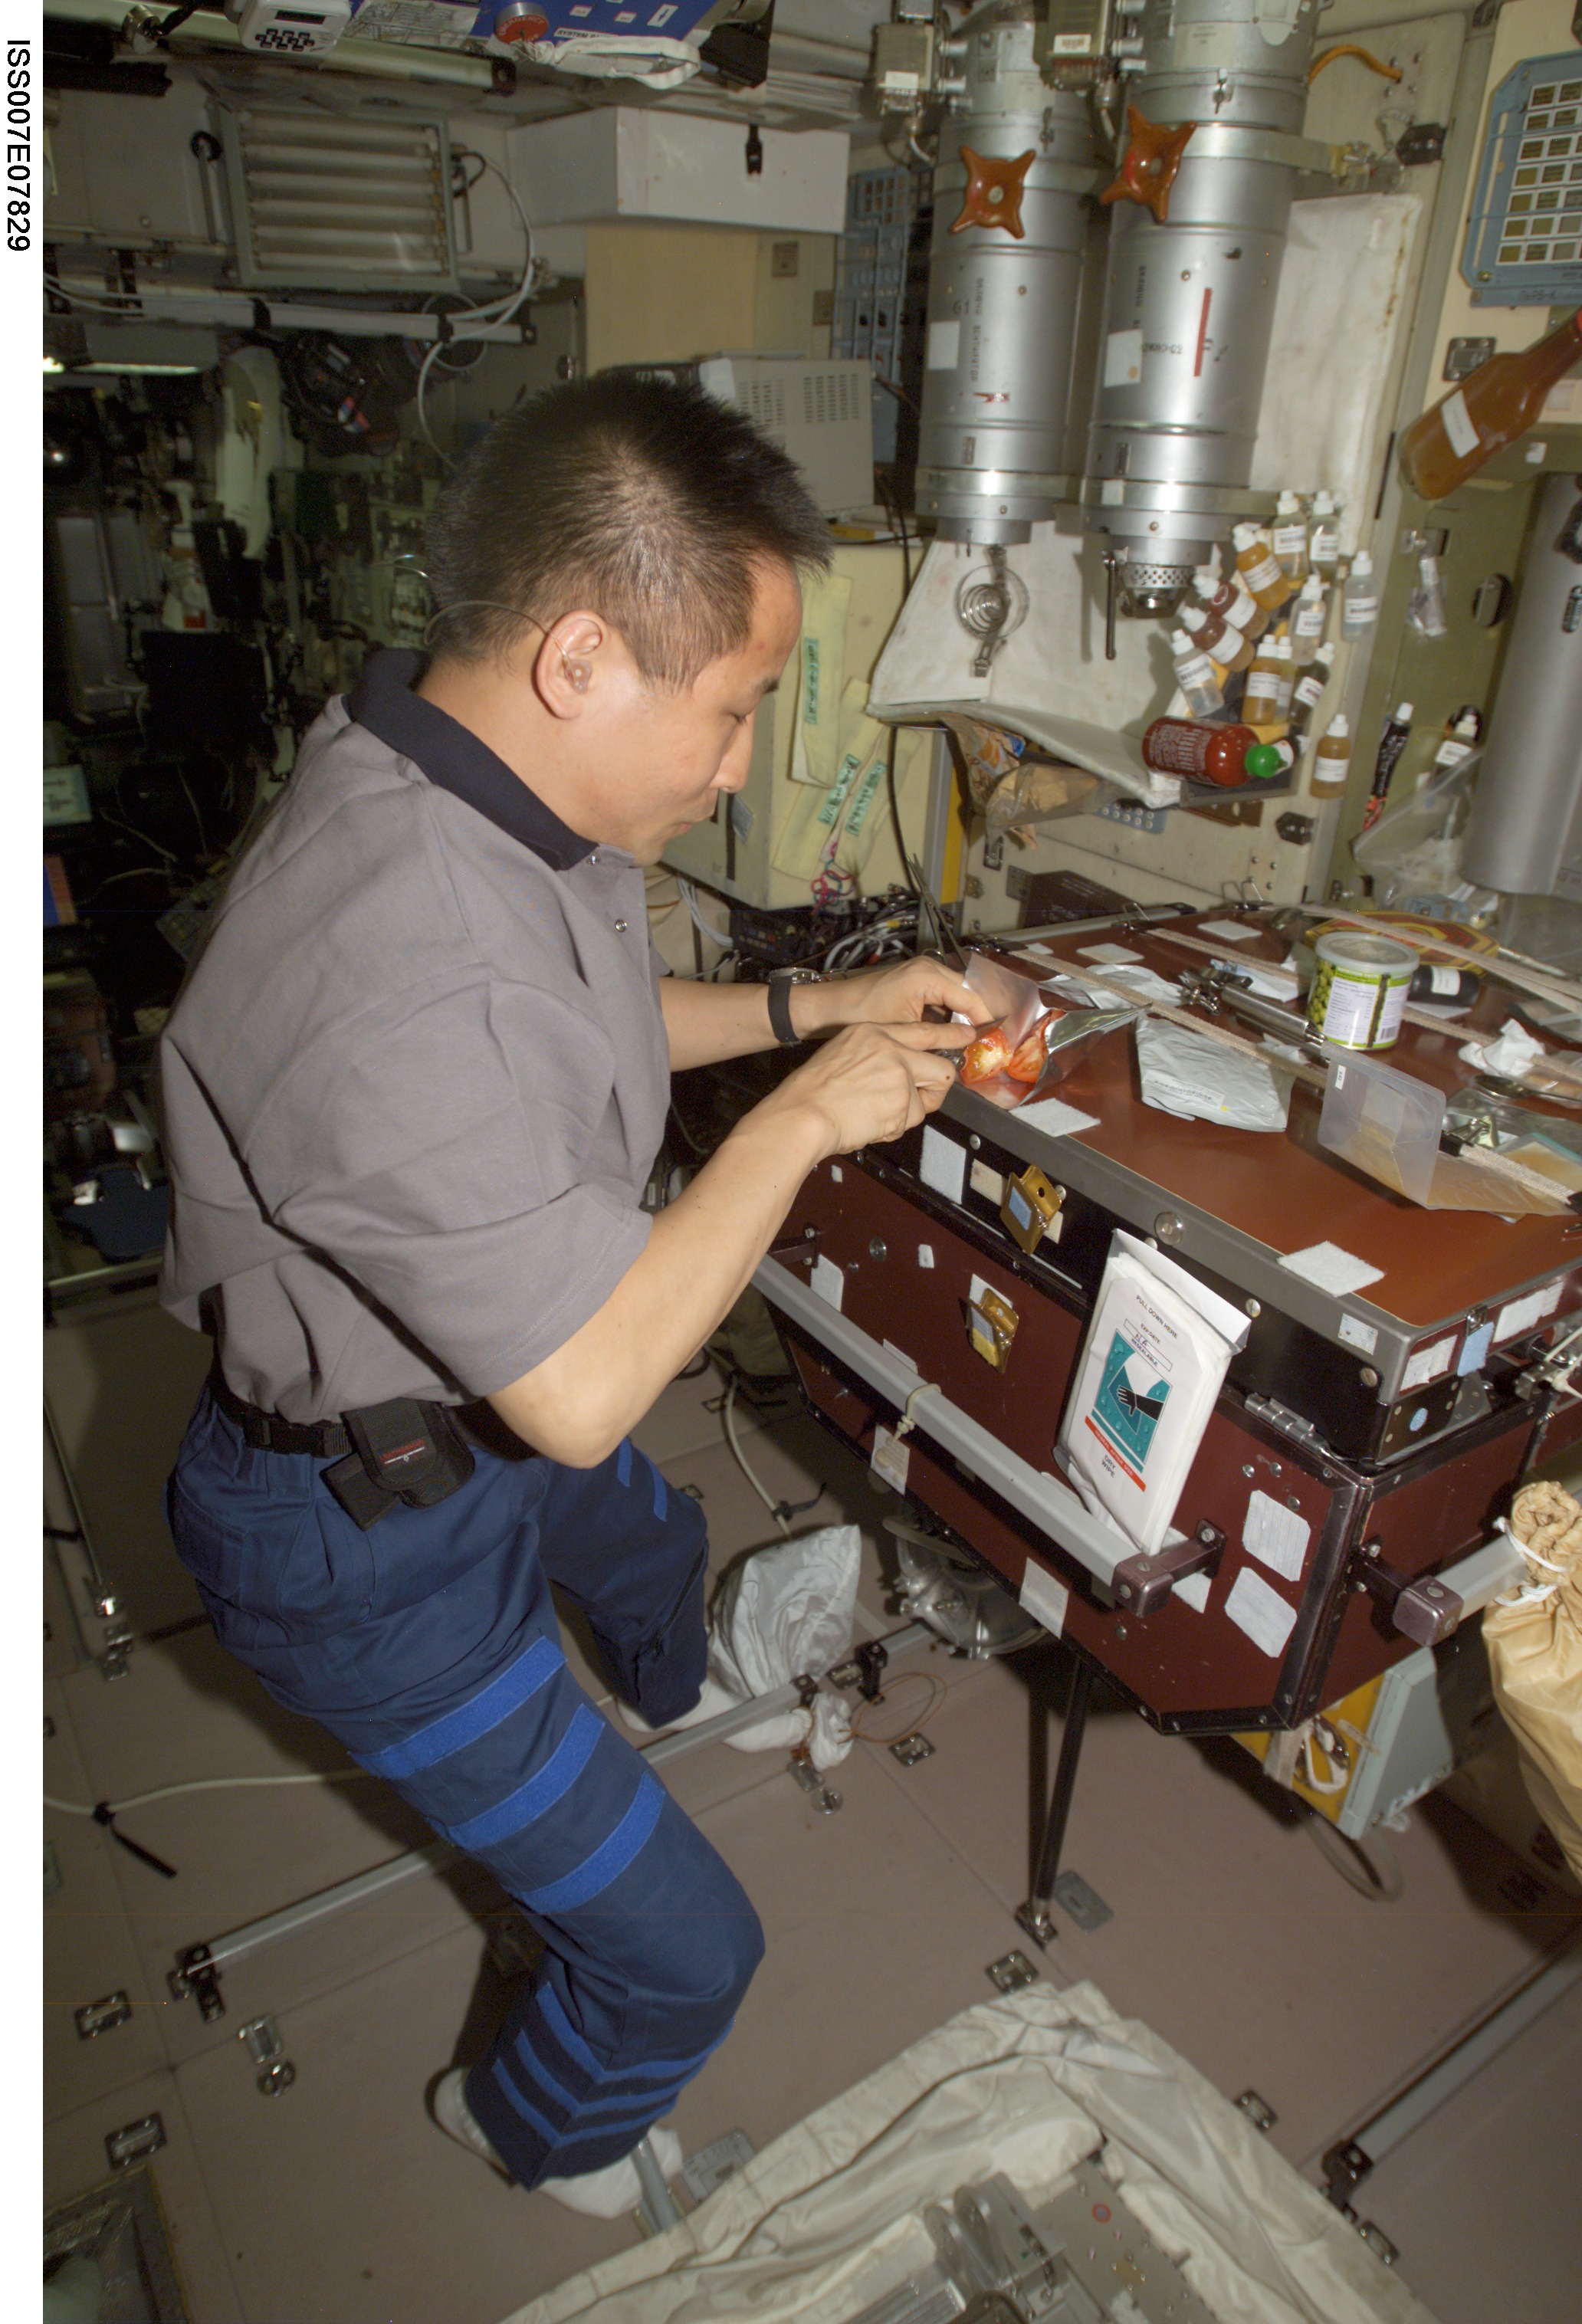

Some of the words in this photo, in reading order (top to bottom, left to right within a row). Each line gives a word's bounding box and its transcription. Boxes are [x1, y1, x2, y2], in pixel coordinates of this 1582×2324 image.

[1136, 1295, 1147, 1310] PULL
[1149, 1308, 1164, 1324] DOWN
[1164, 1323, 1178, 1339] HERE
[1101, 1459, 1114, 1478] WIPE
[1104, 1455, 1115, 1469] DRY
